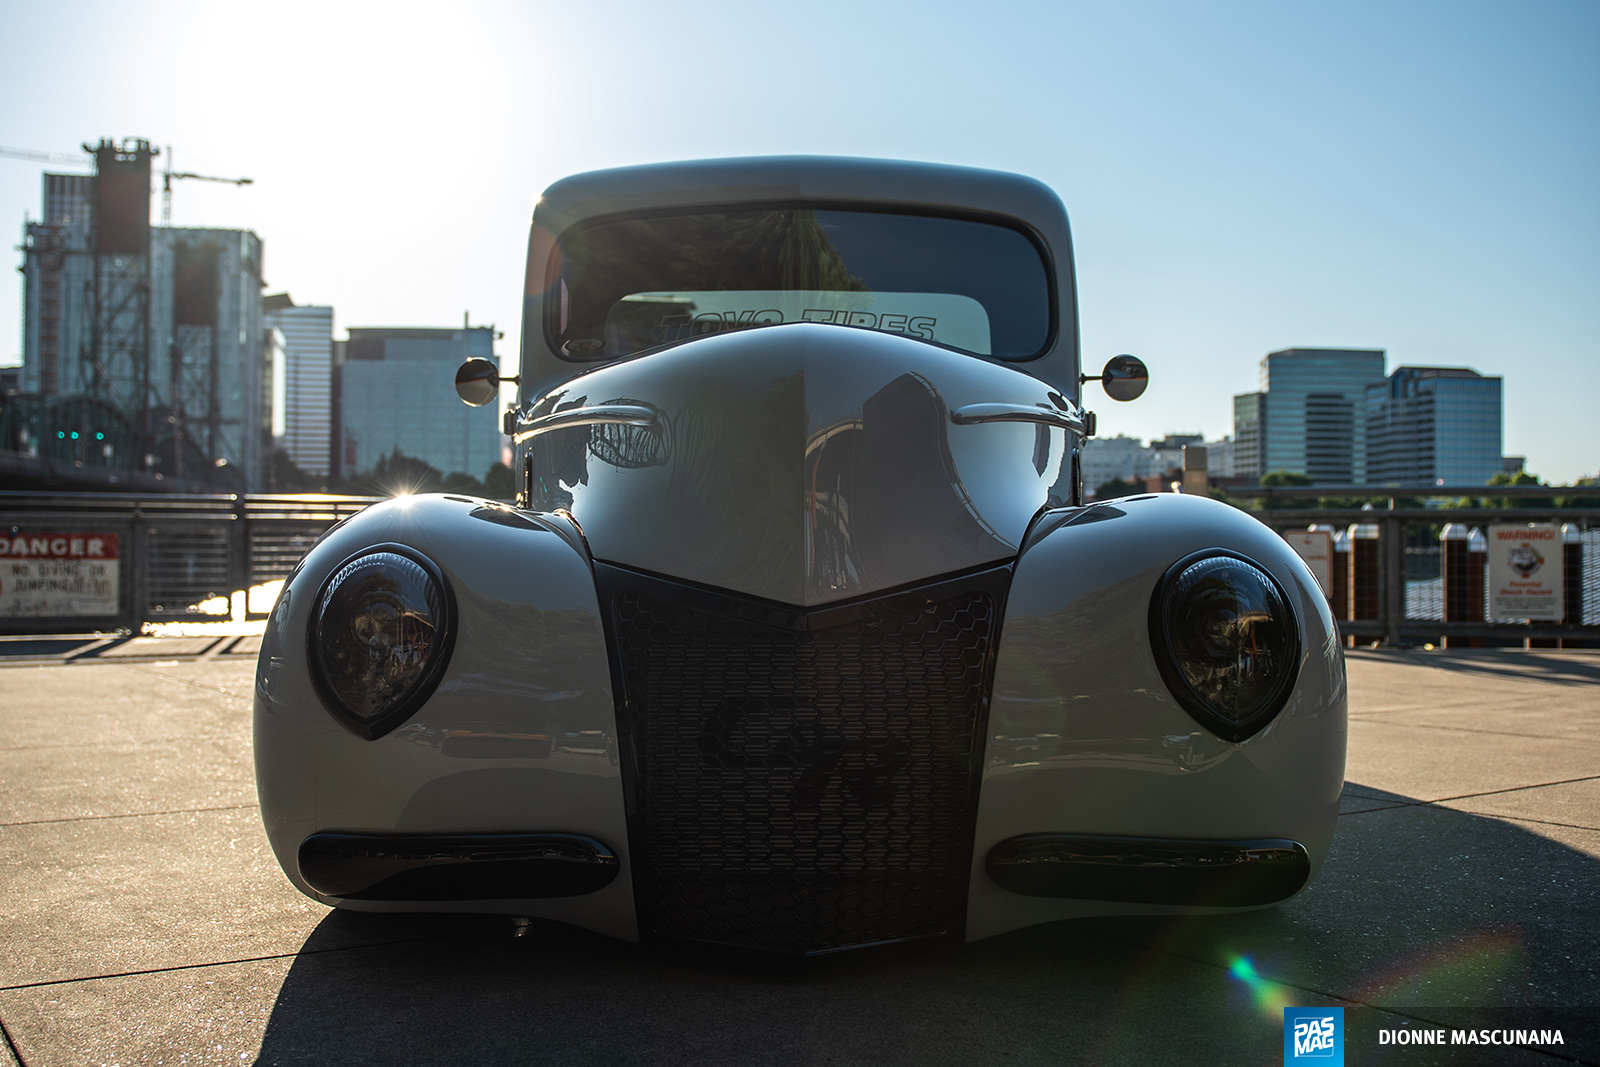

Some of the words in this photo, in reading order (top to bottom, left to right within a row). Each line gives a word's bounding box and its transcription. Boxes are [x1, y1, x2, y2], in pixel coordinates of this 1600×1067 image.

[1497, 529, 1555, 541] WARNING!
[0, 537, 105, 556] DANGER
[12, 564, 30, 577] NO
[39, 563, 81, 577] DIVING
